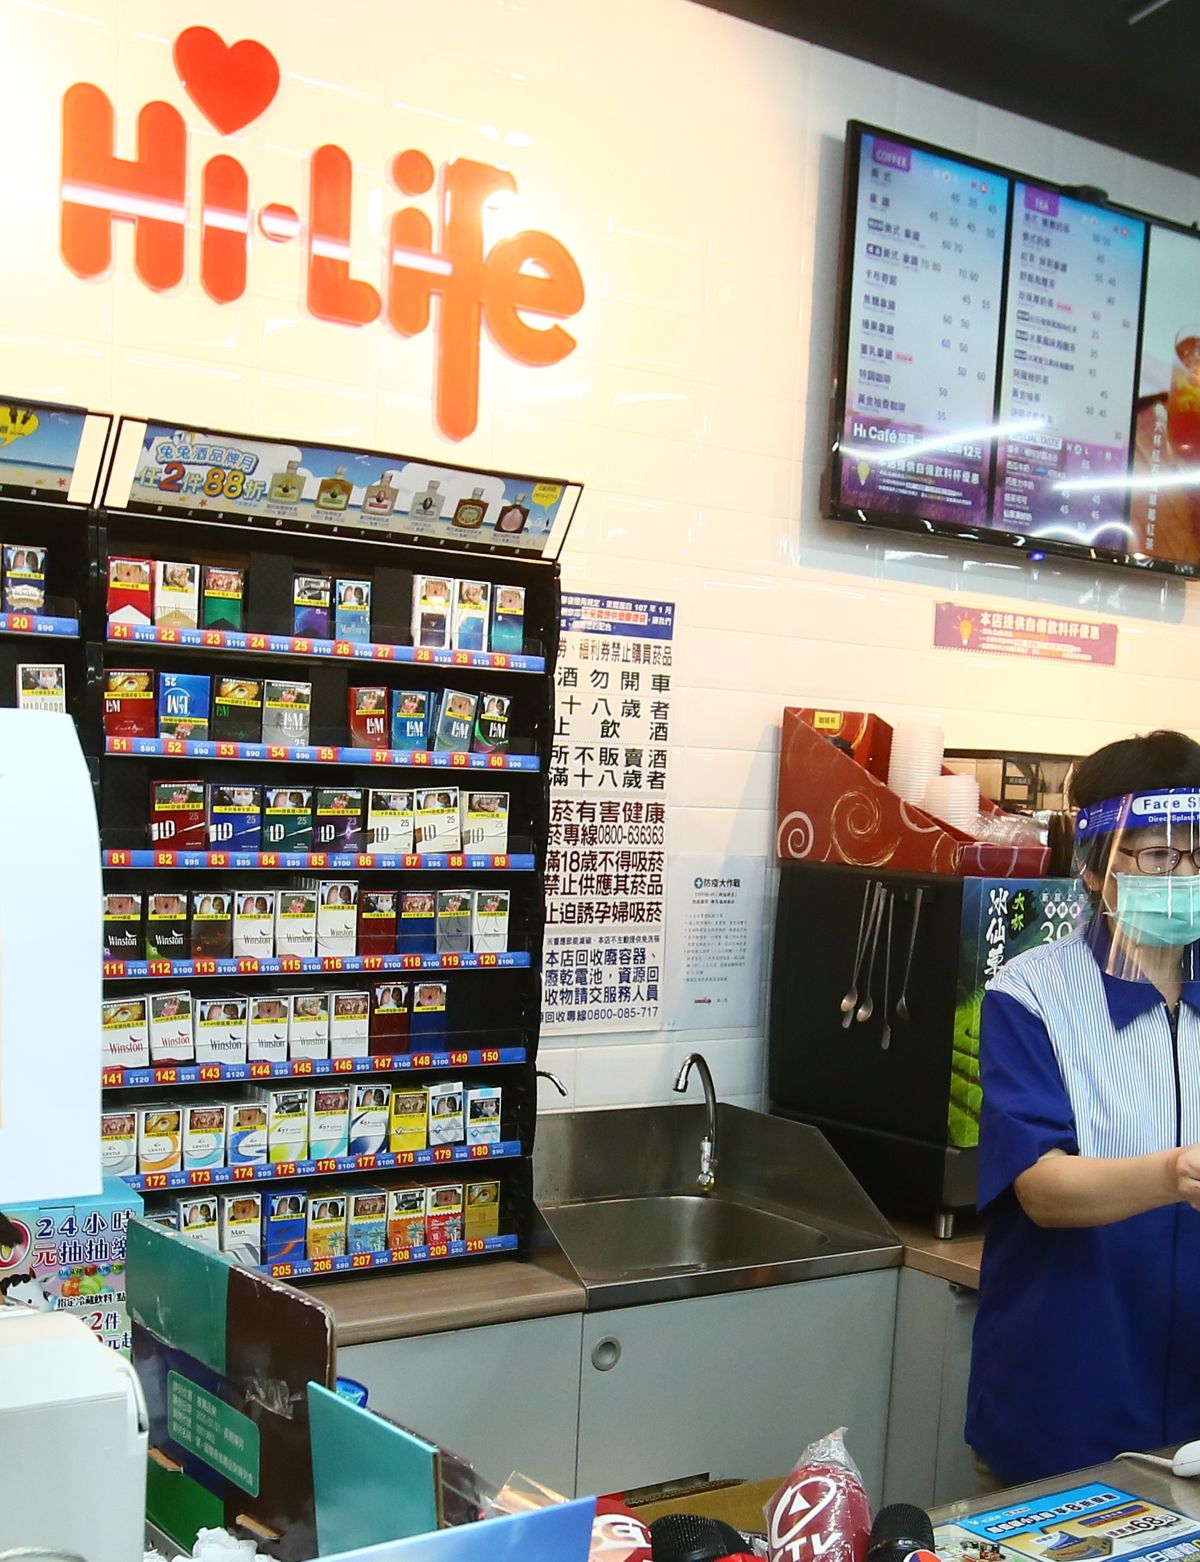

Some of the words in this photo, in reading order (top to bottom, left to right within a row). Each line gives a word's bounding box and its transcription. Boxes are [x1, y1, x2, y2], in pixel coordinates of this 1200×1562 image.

[875, 150, 908, 168] COFFEE
[1034, 199, 1049, 210] TEA
[60, 26, 585, 442] Hi-Life
[869, 426, 897, 444] Café
[158, 444, 258, 474] 兔兔酒品牌月
[139, 462, 267, 500] 任2件88折
[1060, 504, 1069, 515] 45
[1091, 509, 1100, 520] 45
[634, 604, 648, 612] 107
[12, 616, 28, 629] 20
[37, 623, 54, 632] $90
[980, 611, 1100, 641] 本店提供自備飲料杯優惠
[160, 629, 176, 641] 22
[181, 635, 201, 644] $110
[250, 636, 266, 648] 24
[336, 643, 350, 655] 26
[354, 649, 373, 658] $100
[455, 652, 468, 664] 29
[510, 660, 527, 669] $125
[164, 677, 176, 687] 25
[561, 695, 670, 721] 十八歲者
[366, 717, 384, 735] L&M
[452, 720, 469, 739] L&M
[113, 739, 128, 750] 51
[194, 747, 209, 756] $90
[220, 744, 234, 756] 53
[375, 752, 388, 763] 57
[453, 754, 465, 765] 59
[551, 800, 666, 824] 菸有害健康
[1143, 798, 1181, 811] Face
[400, 819, 410, 828] 25
[446, 815, 455, 824] 25
[217, 822, 233, 842] LD
[269, 823, 285, 842] LD
[320, 824, 335, 843] LD
[111, 853, 126, 864] 81
[184, 858, 200, 866] $95
[210, 854, 225, 865] 83
[359, 855, 372, 866] 86
[450, 856, 463, 866] 88
[544, 873, 663, 897] 禁止供應其菸品
[703, 878, 741, 889] 防疫大作戰
[108, 934, 137, 947] Winston
[330, 928, 354, 938] Winston
[104, 961, 124, 975] 111
[238, 958, 259, 972] 114
[323, 956, 342, 969] 116
[403, 954, 421, 967] 118
[479, 952, 496, 965] 120
[544, 984, 659, 1006] 收物請交服務人員
[161, 1037, 190, 1048] Winston
[258, 1038, 285, 1049] Winston
[129, 1076, 150, 1084] $120
[200, 1067, 221, 1079] 143
[293, 1061, 312, 1074] 145
[374, 1058, 392, 1070] 147
[481, 1051, 499, 1062] 150
[190, 1170, 211, 1183] 173
[276, 1163, 295, 1176] 175
[357, 1155, 376, 1168] 177
[471, 1145, 488, 1157] 180
[36, 1208, 135, 1239] 24小時
[293, 1265, 311, 1275] $100
[313, 1259, 332, 1273] 206
[392, 1250, 411, 1262] 208
